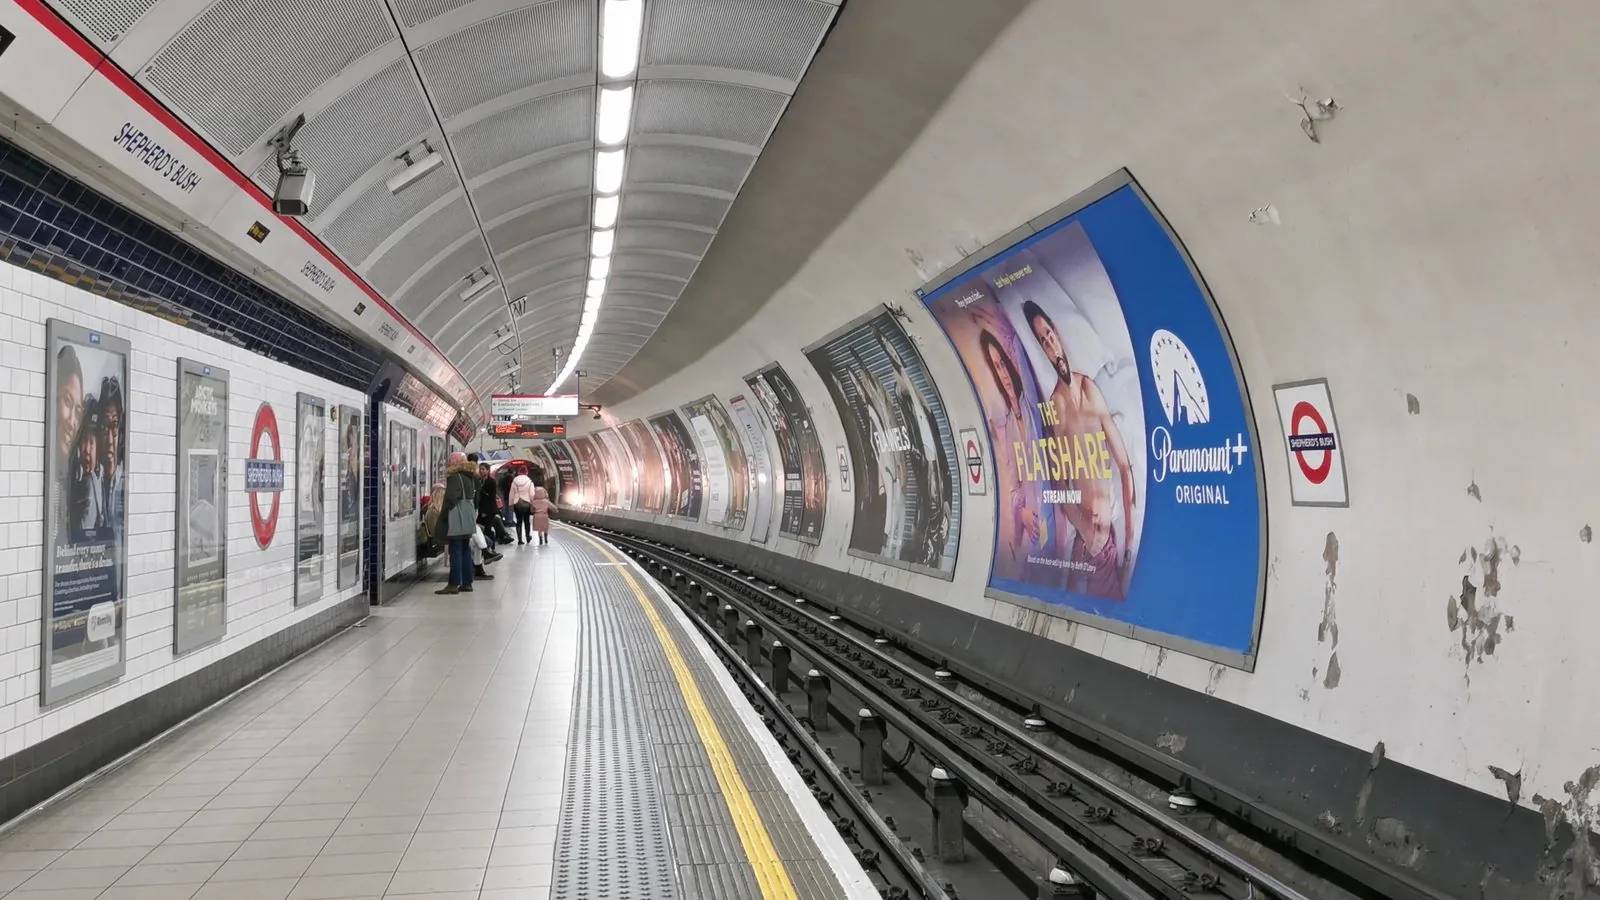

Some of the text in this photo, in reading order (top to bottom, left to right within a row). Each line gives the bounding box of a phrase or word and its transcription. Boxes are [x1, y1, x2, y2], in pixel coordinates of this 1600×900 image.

[113, 122, 202, 194] SHEPHERD'S BUSH
[1037, 400, 1060, 427] THE
[1151, 426, 1248, 482] Paramount+
[1319, 437, 1334, 447] BUSH
[1013, 431, 1113, 481] FLATSHARE
[1043, 489, 1082, 504] STREAM NOW
[1176, 485, 1230, 504] ORIGINAL
